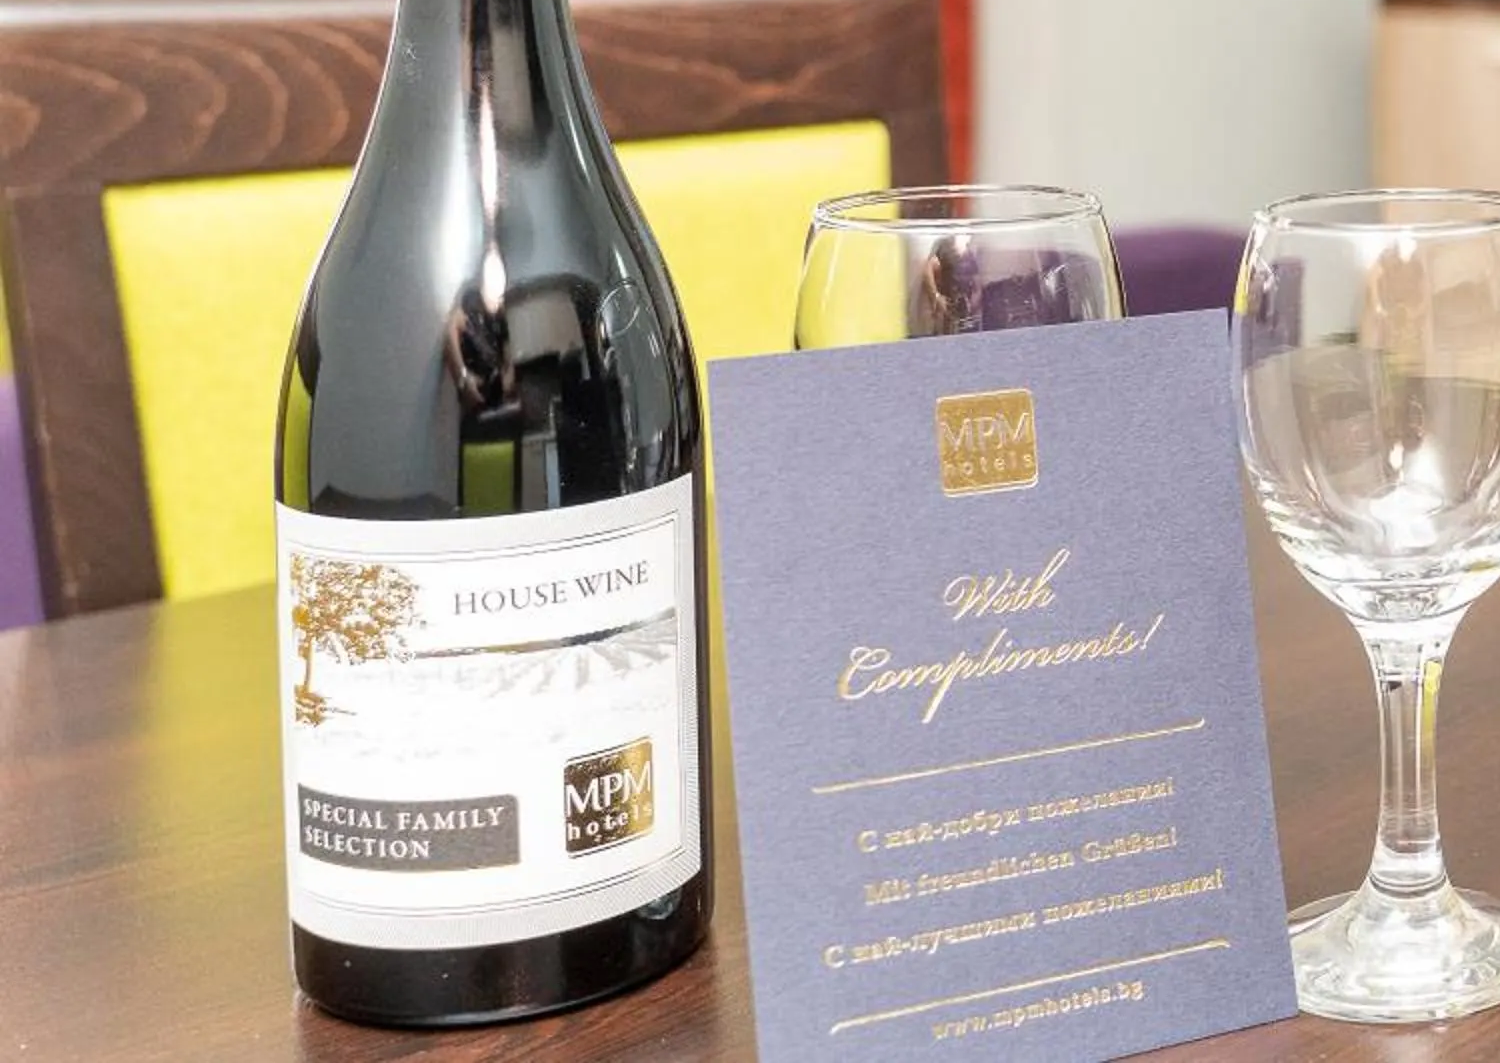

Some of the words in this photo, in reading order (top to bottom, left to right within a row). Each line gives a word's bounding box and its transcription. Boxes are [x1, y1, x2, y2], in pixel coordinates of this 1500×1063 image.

[940, 412, 1030, 454] MPM
[943, 452, 1033, 479] hotels
[454, 581, 568, 615] HOUSE
[575, 561, 650, 599] WINE
[944, 548, 1070, 621] With
[838, 614, 1165, 724] Compliments!
[564, 760, 651, 817] MPM
[303, 798, 388, 830] SPECIAL
[397, 806, 505, 830] FAMILY
[567, 803, 653, 841] hotels
[303, 826, 430, 858] SELECTION
[932, 980, 1145, 1039] www.mpmhotels.bg
